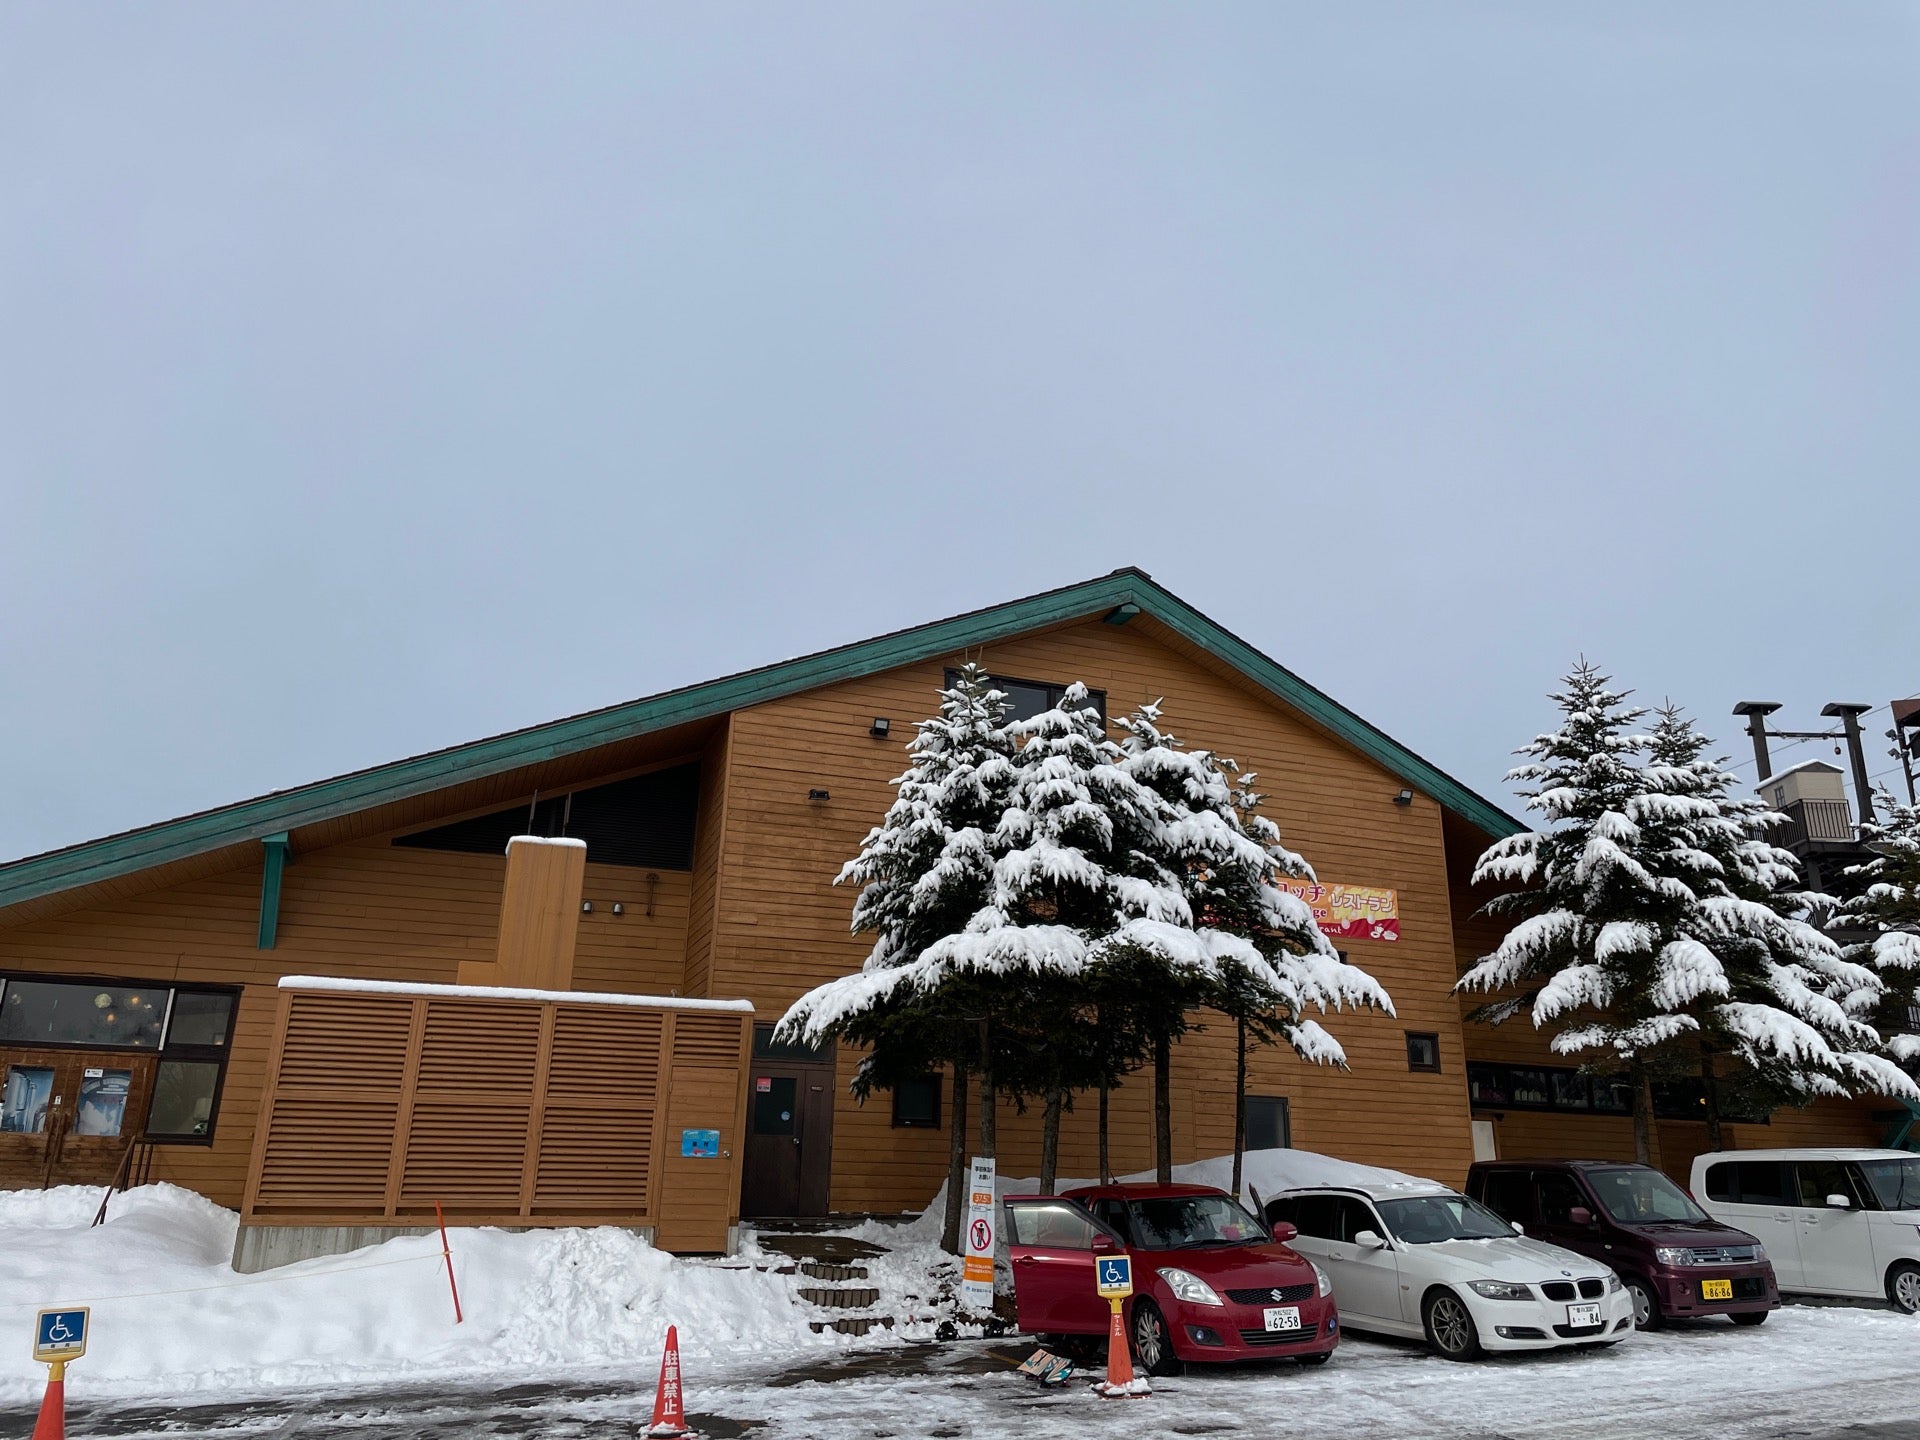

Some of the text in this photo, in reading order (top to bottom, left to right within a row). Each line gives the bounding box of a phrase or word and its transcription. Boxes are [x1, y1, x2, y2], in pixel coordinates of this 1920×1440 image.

[1330, 893, 1394, 912] レストラン
[1311, 907, 1327, 919] ge
[1273, 1316, 1299, 1329] 62-58
[663, 1350, 678, 1416] 駐車禁止
